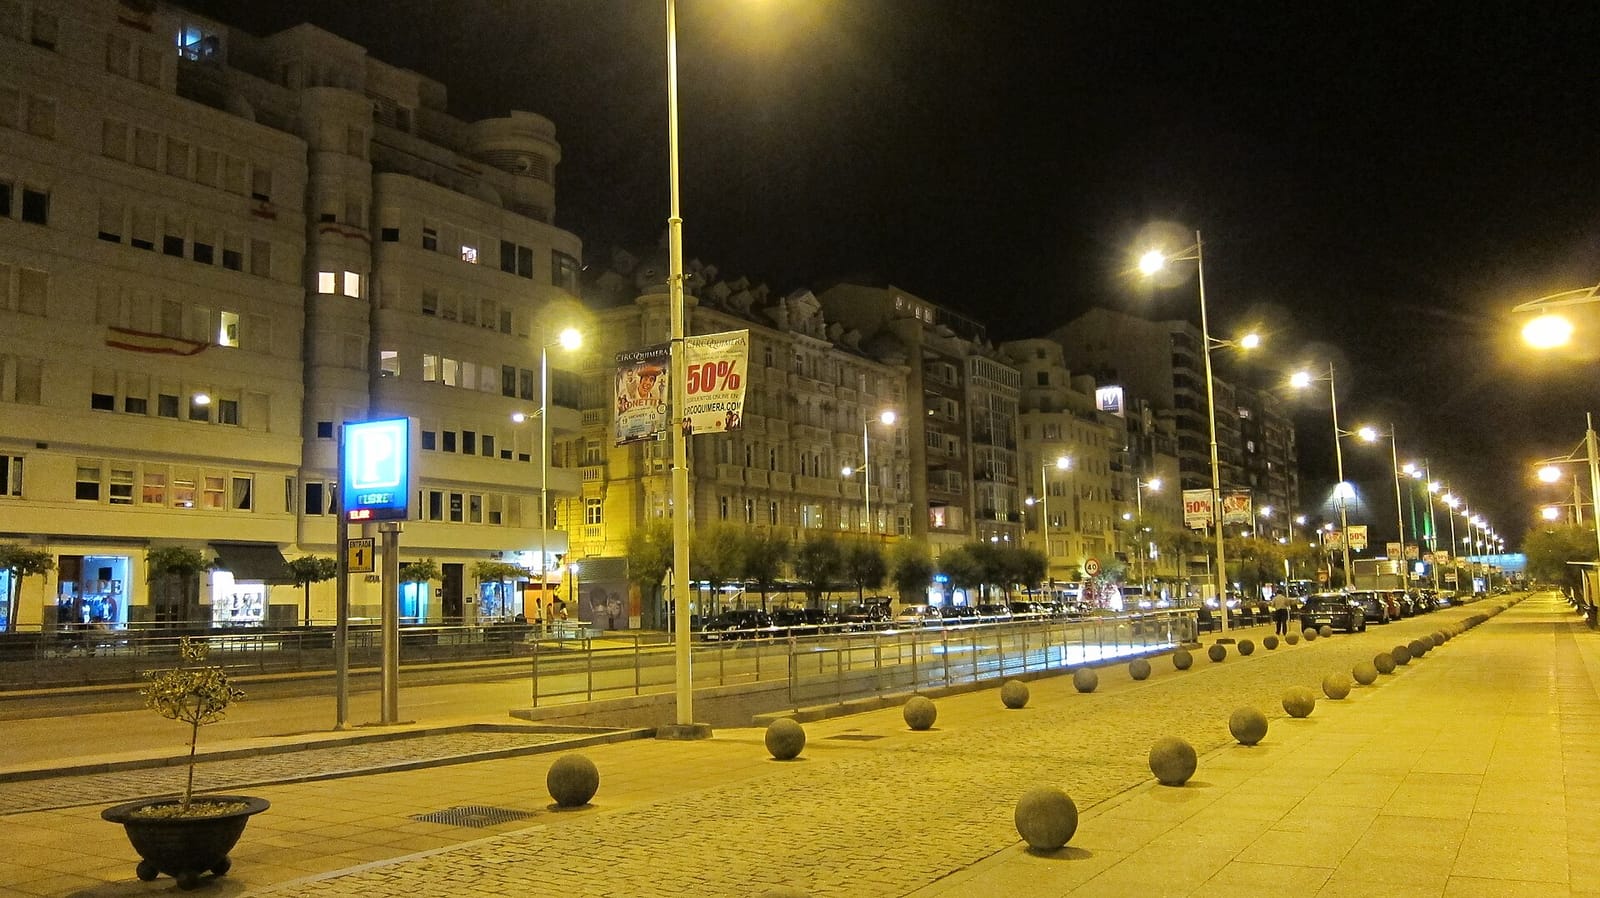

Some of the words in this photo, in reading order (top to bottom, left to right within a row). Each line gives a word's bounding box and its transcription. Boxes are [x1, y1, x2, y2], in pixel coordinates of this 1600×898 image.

[687, 360, 740, 395] 50%
[361, 431, 392, 482] P
[1186, 501, 1211, 513] 50%
[350, 540, 371, 548] ENTRADA
[355, 549, 363, 566] 1
